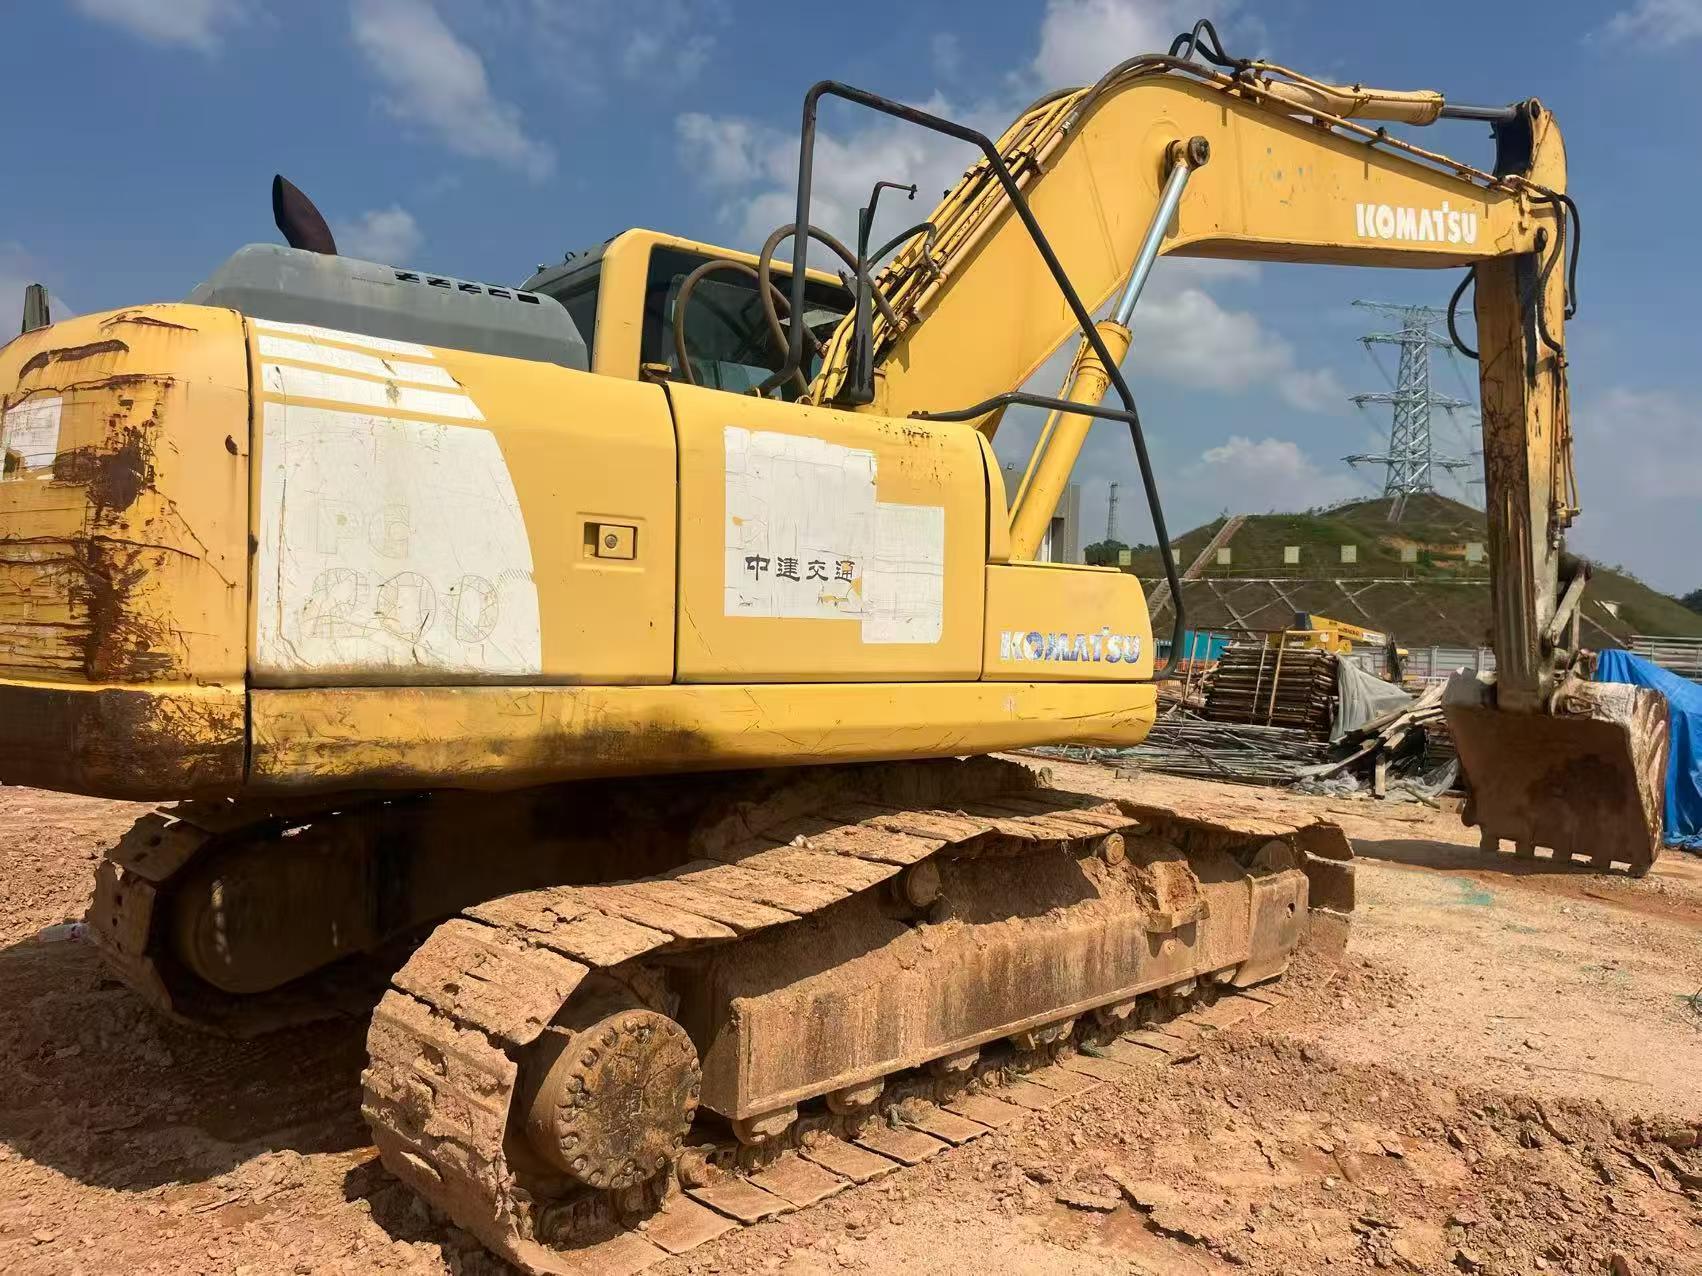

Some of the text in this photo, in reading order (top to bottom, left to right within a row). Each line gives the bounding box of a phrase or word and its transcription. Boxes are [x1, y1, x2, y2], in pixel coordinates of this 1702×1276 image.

[1355, 200, 1477, 244] KOMATSU
[745, 553, 856, 583] 中建交通
[1000, 626, 1141, 664] KOMATSU
